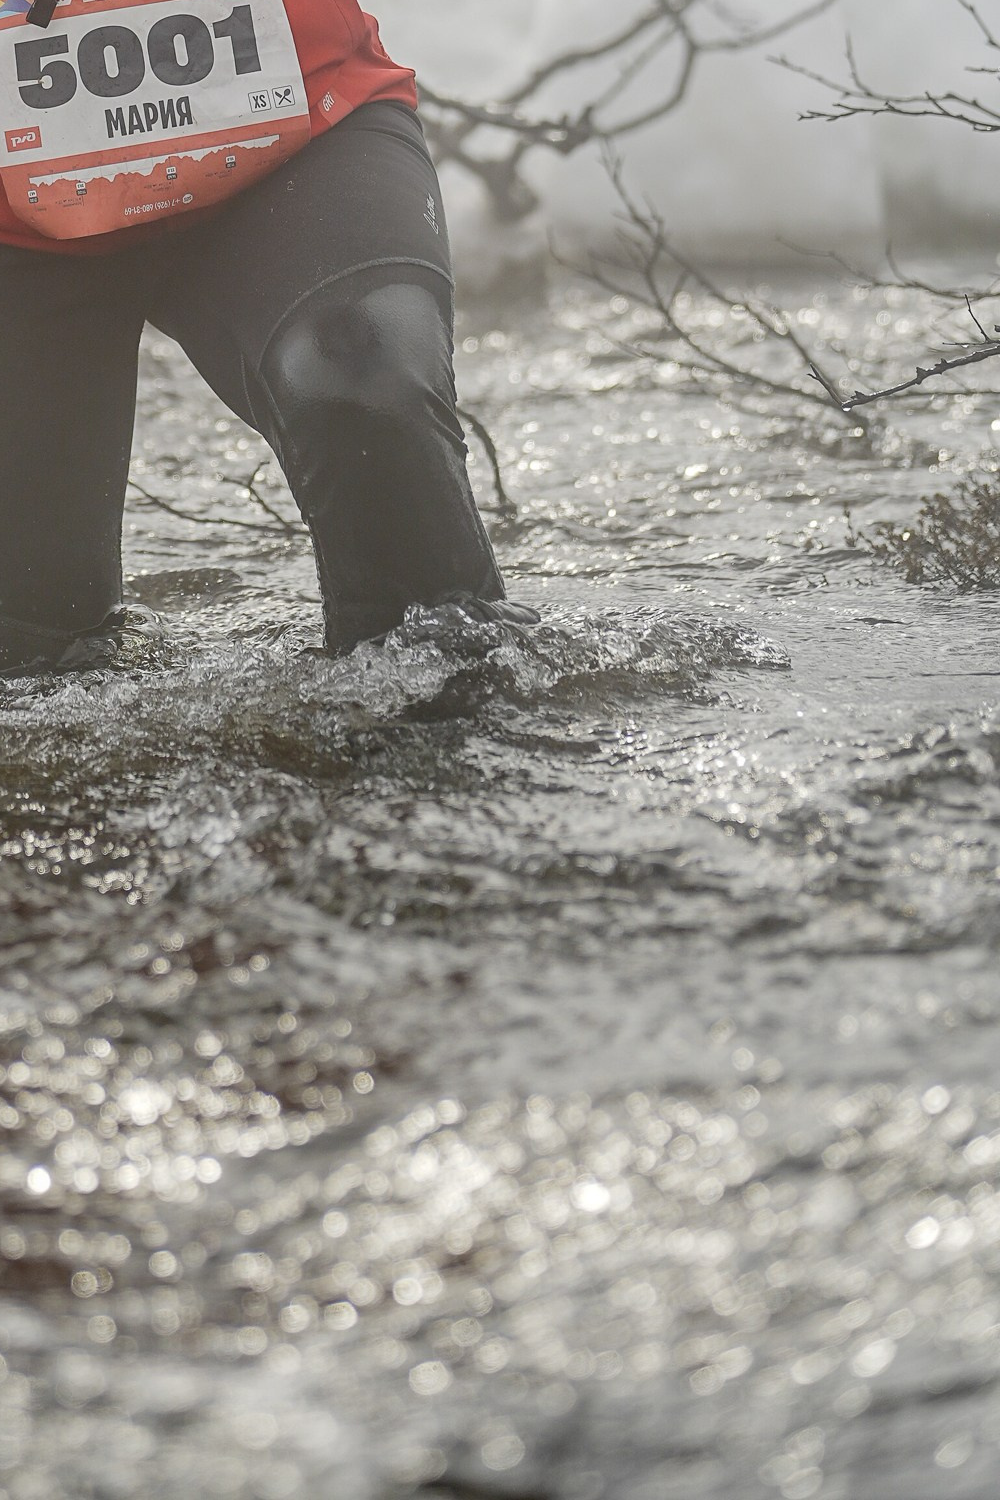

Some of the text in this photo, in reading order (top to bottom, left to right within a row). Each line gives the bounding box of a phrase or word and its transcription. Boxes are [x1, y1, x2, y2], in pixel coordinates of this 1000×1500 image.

[14, 4, 262, 110] 5001
[104, 96, 194, 138] МАРИЯ
[252, 94, 267, 109] XS
